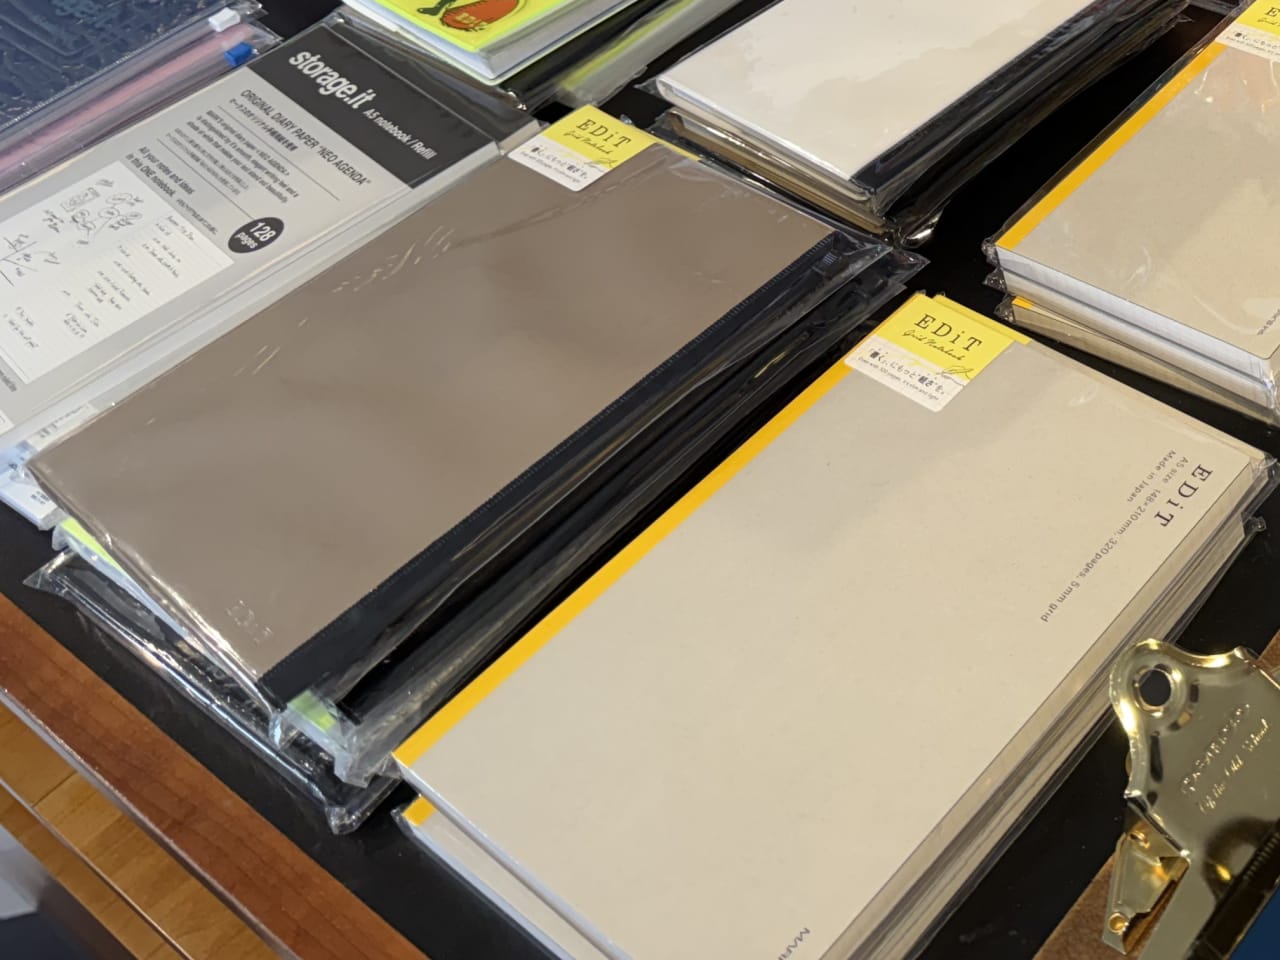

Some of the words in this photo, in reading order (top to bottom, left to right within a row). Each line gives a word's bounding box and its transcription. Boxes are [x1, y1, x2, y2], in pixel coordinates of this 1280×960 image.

[289, 51, 376, 109] storage.it
[238, 88, 277, 116] ORIGINAL
[269, 112, 297, 131] DIARY
[290, 128, 320, 148] PAPER
[363, 108, 380, 119] A5
[375, 116, 412, 144] notebook
[411, 140, 438, 160] Refill
[576, 119, 632, 148] EDiT
[137, 145, 150, 155] All
[142, 151, 161, 165] your
[128, 157, 145, 168] this
[138, 165, 156, 178] ONE
[154, 161, 175, 176] notes
[167, 172, 184, 184] and
[177, 180, 197, 194] ideas
[234, 231, 258, 249] pages
[251, 222, 276, 242] 128
[914, 313, 984, 352] EDiT
[1156, 449, 1177, 472] Made
[1176, 457, 1190, 471] A5
[1162, 467, 1180, 484] size
[1126, 478, 1151, 504] Japan
[1154, 463, 1214, 528] EDiT
[1039, 601, 1060, 623] grid
